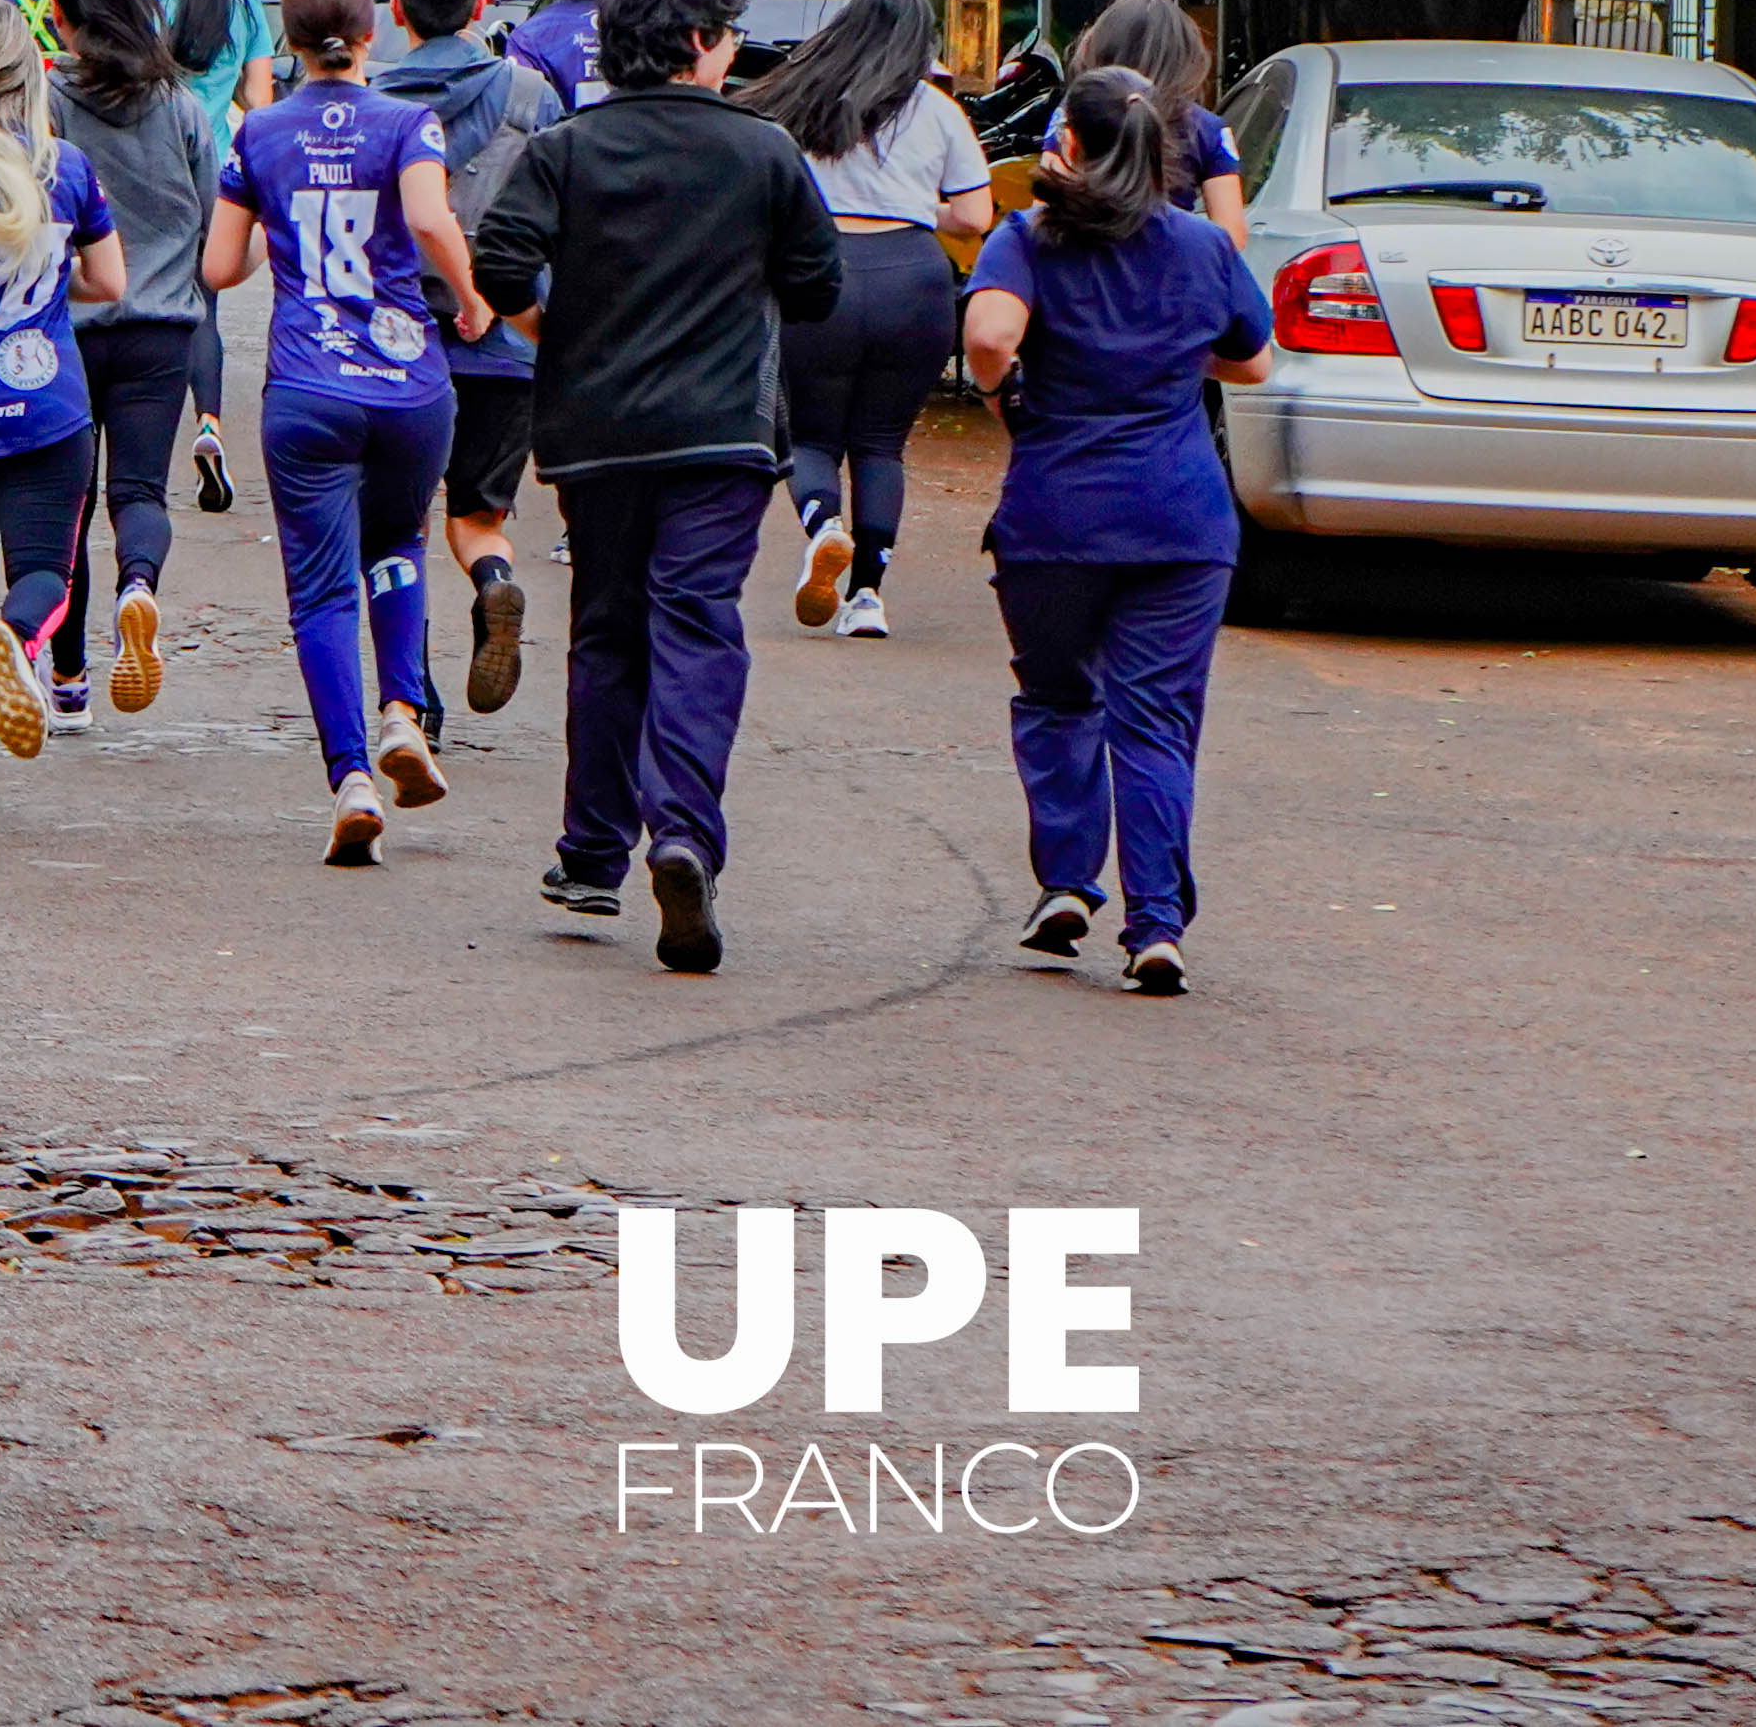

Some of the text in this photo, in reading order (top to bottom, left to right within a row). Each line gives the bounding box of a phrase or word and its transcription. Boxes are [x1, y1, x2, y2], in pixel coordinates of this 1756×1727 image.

[308, 163, 353, 185] PAULI
[290, 190, 379, 300] 18
[1574, 295, 1638, 307] PARAGUAY
[1531, 306, 1667, 340] AABC 042
